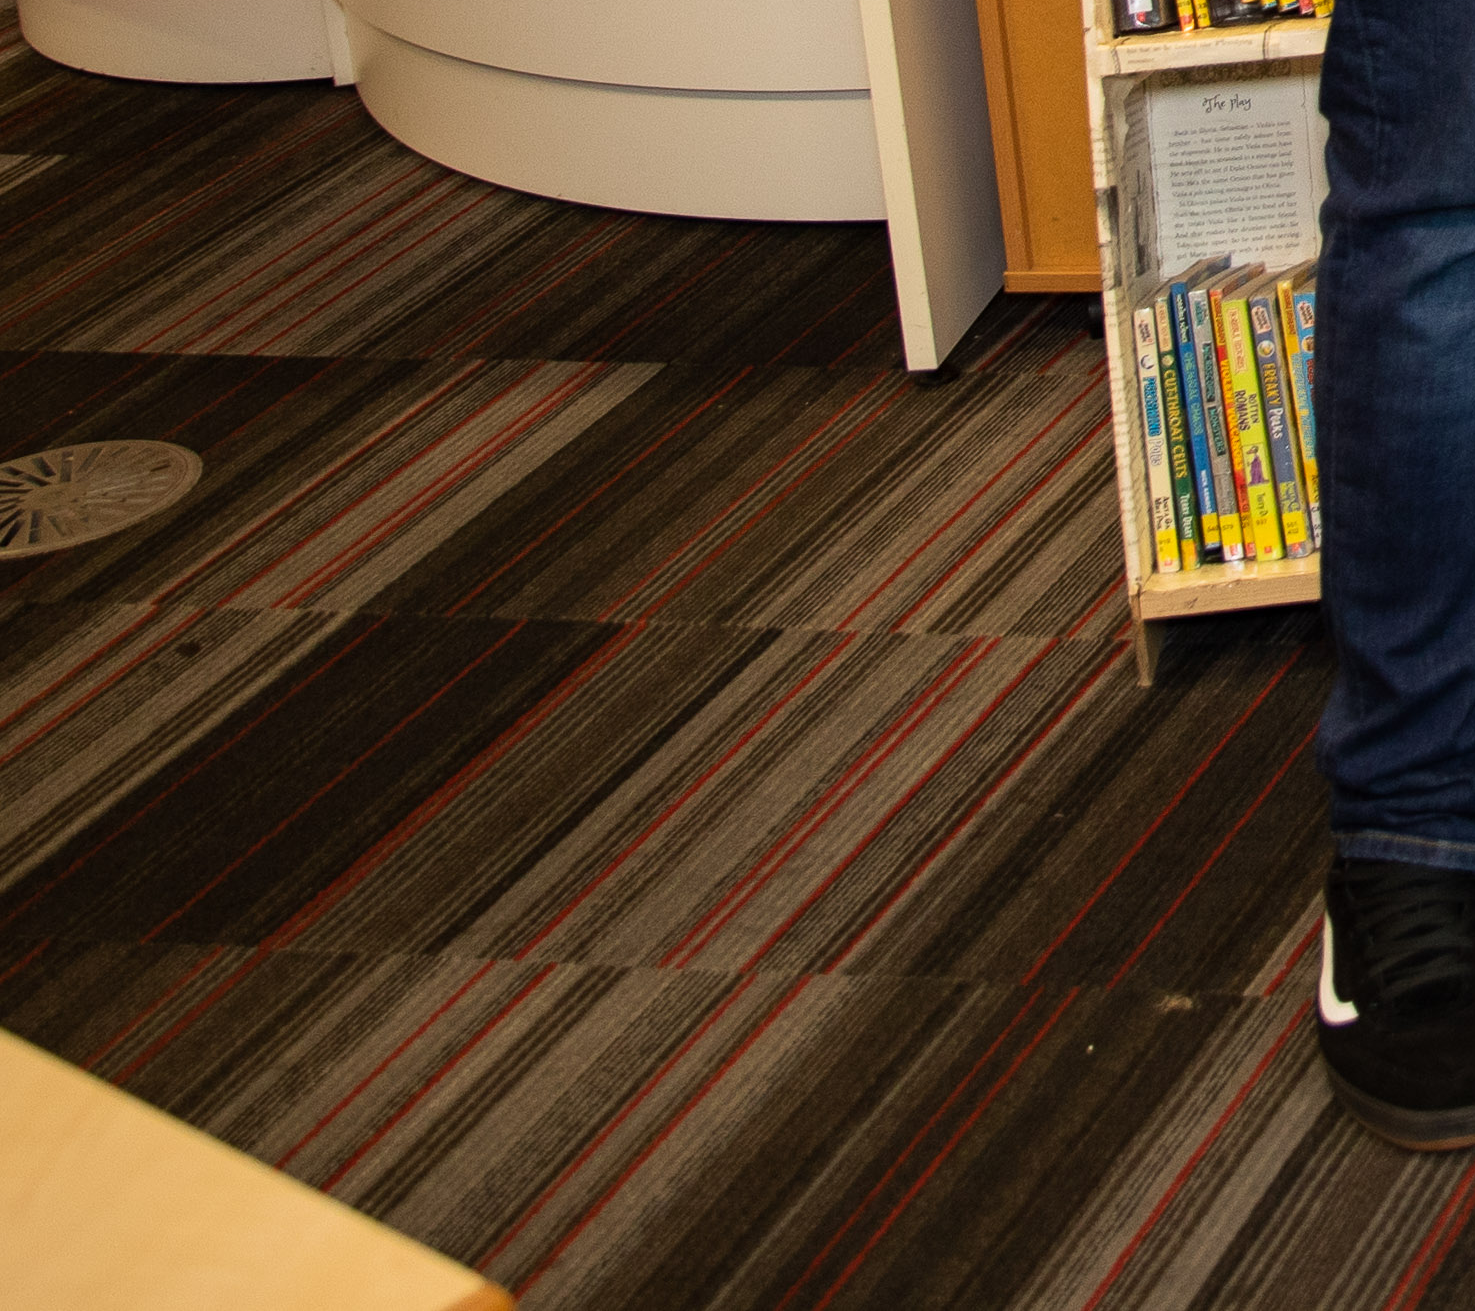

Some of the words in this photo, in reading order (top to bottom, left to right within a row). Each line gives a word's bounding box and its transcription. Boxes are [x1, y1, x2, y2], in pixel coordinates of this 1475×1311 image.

[1202, 94, 1226, 113] The
[1229, 94, 1252, 112] play
[1261, 363, 1280, 411] FREAKY
[1162, 369, 1182, 442] CUTTHROAT
[1172, 443, 1188, 479] CELTS
[1234, 390, 1250, 431] ROMANS
[1248, 393, 1260, 423] ROTTEN
[1268, 407, 1283, 439] Peaks
